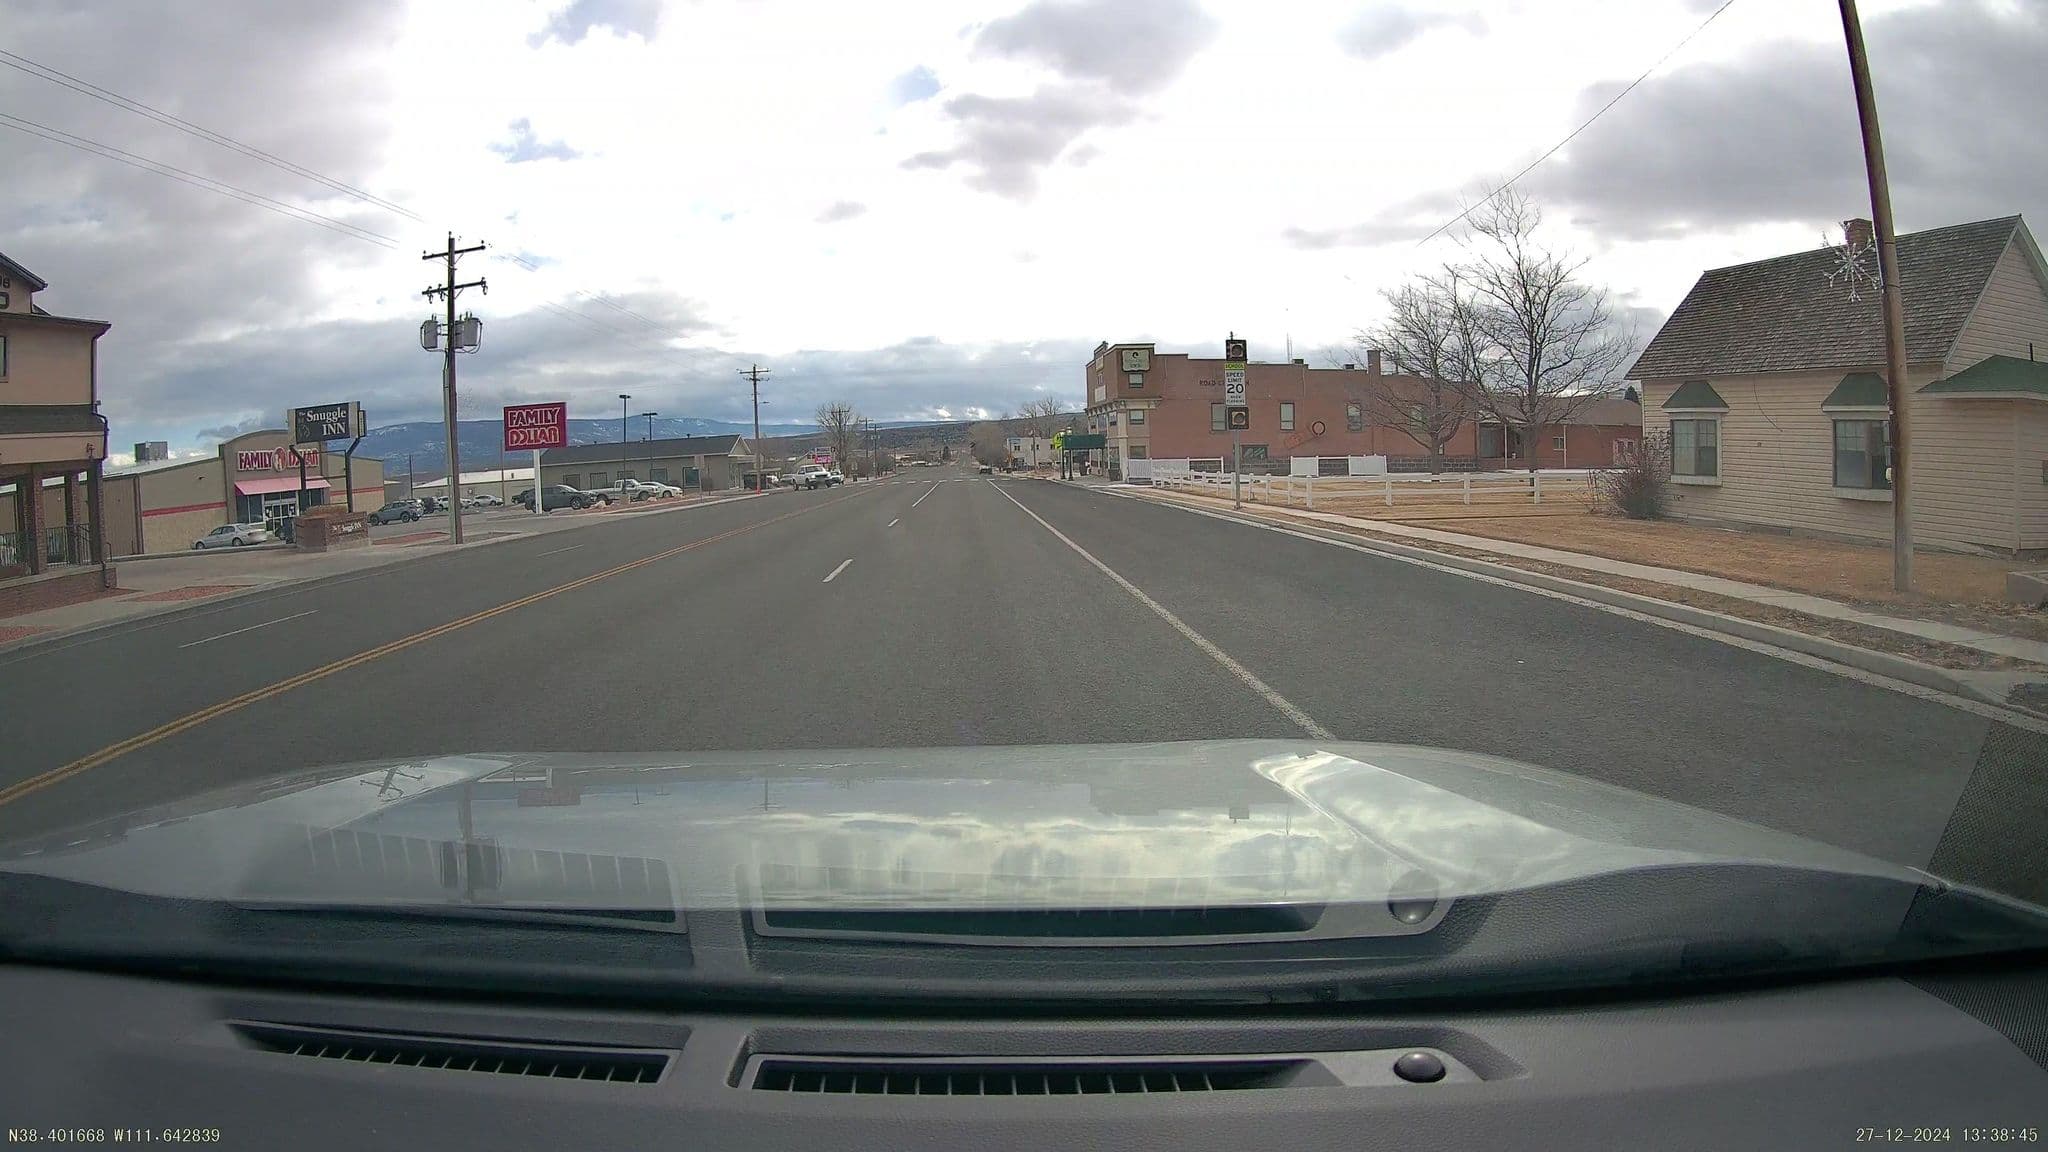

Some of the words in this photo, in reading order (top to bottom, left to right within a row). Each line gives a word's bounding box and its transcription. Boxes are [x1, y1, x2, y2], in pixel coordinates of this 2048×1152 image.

[1227, 383, 1244, 394] 20
[306, 407, 347, 423] Snuggle
[508, 407, 560, 428] FAMILY
[323, 422, 346, 436] INN
[508, 426, 560, 447] DOLLAR
[238, 449, 274, 471] FAMILY
